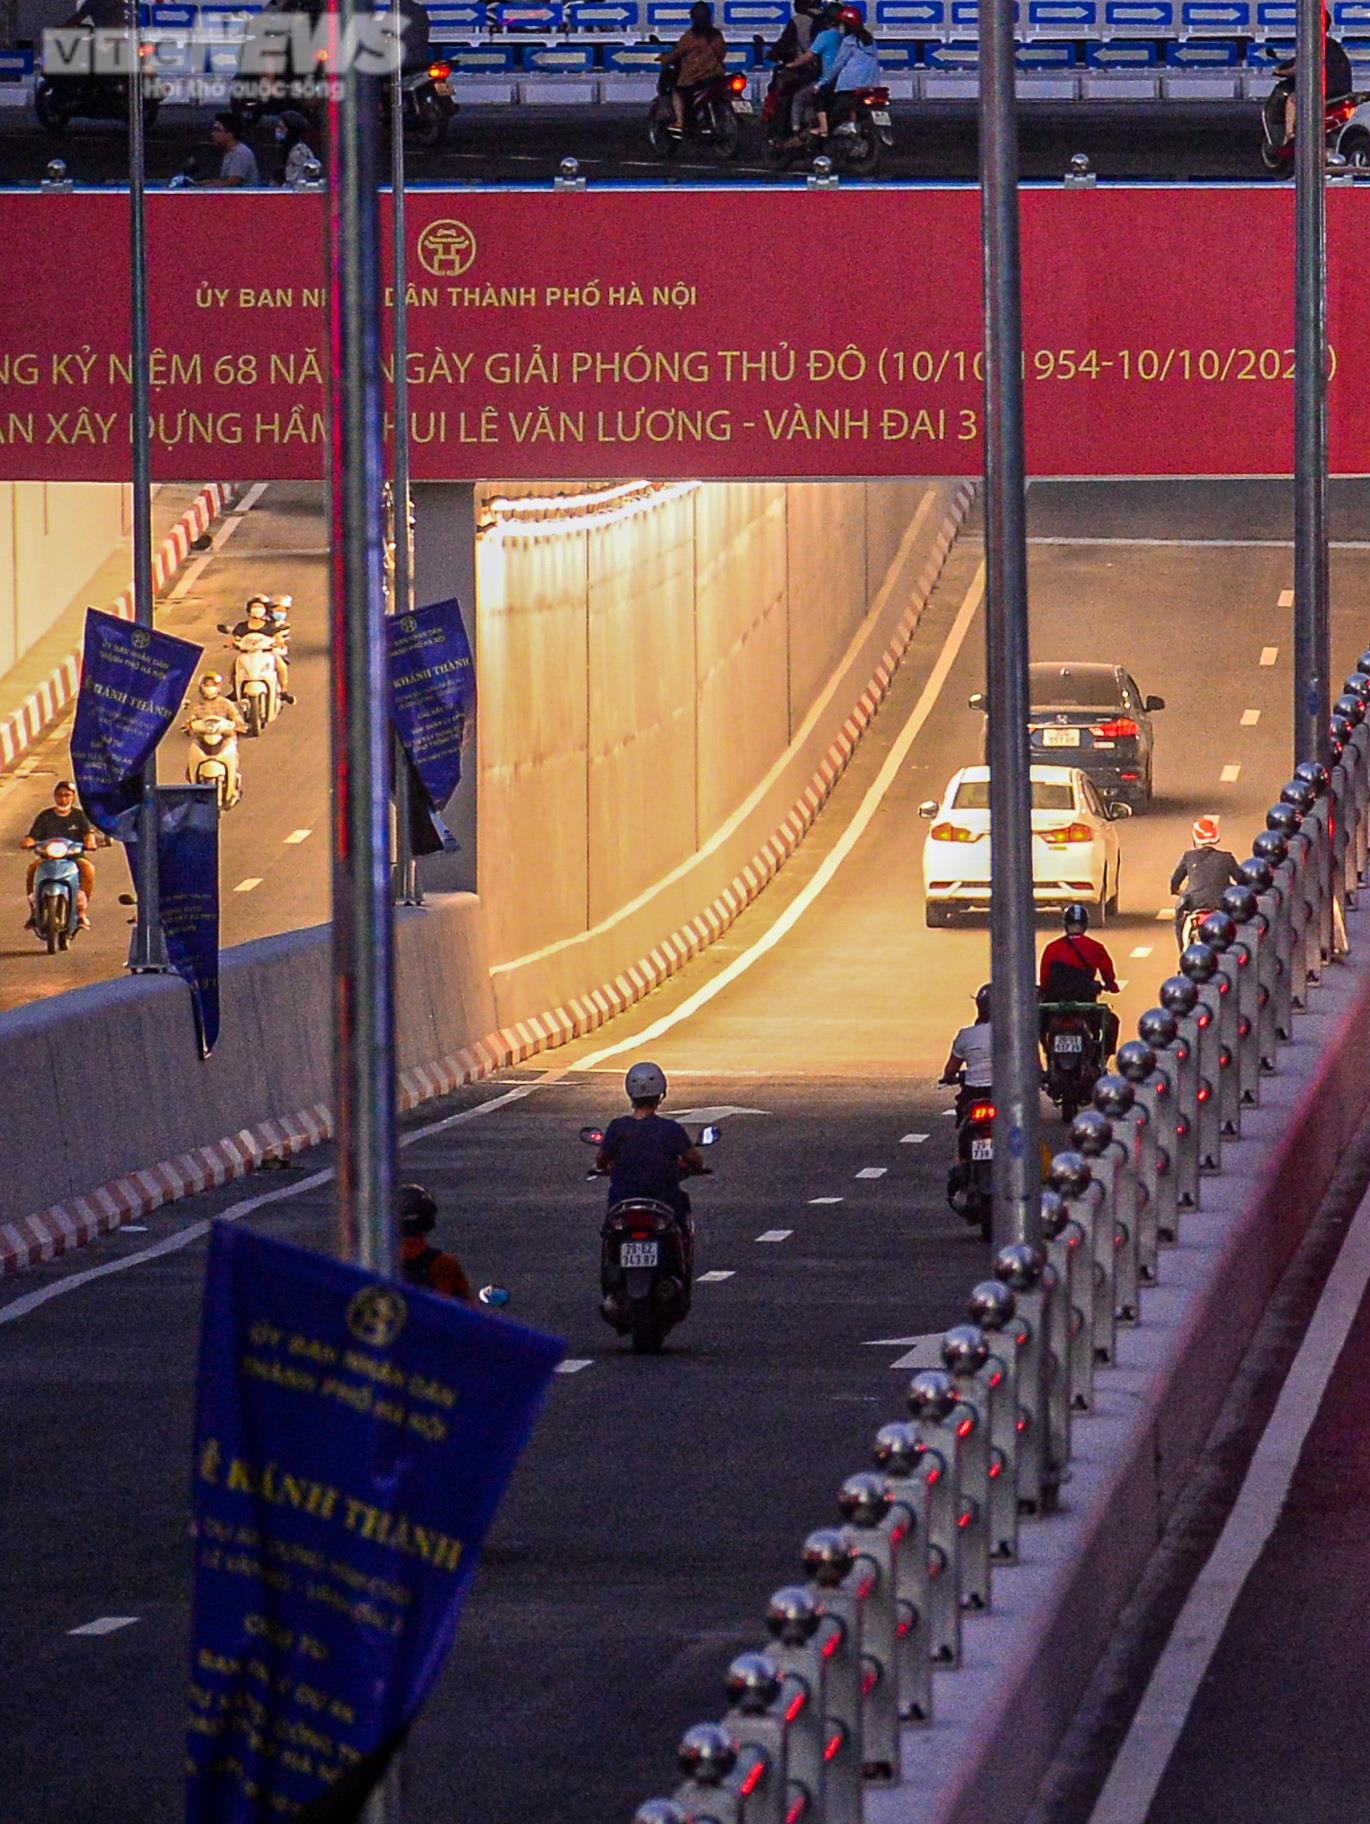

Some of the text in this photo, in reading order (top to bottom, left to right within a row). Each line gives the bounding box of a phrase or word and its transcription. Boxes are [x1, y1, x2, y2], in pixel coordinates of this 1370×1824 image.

[196, 281, 230, 308] ỦY
[239, 288, 293, 308] BAN
[447, 282, 536, 307] THÀNH
[546, 278, 601, 307] PHỐ
[608, 281, 645, 307] HÀ
[653, 281, 696, 310] NỘI
[52, 344, 98, 385] KỶ
[109, 347, 202, 392] NỆM
[214, 354, 258, 385] 68
[270, 347, 324, 385] NĂ
[484, 343, 558, 384] GIẢI
[572, 345, 709, 384] PHÓNG
[717, 341, 796, 382] THỦ
[806, 343, 866, 382] ĐÔ
[46, 406, 117, 444] XÂY
[459, 405, 498, 443] LÊ
[507, 405, 583, 443] VĂN
[598, 406, 731, 443] LƯƠNG
[764, 403, 868, 440] VÀNH
[880, 409, 944, 440] ĐAI
[958, 410, 977, 440] 3
